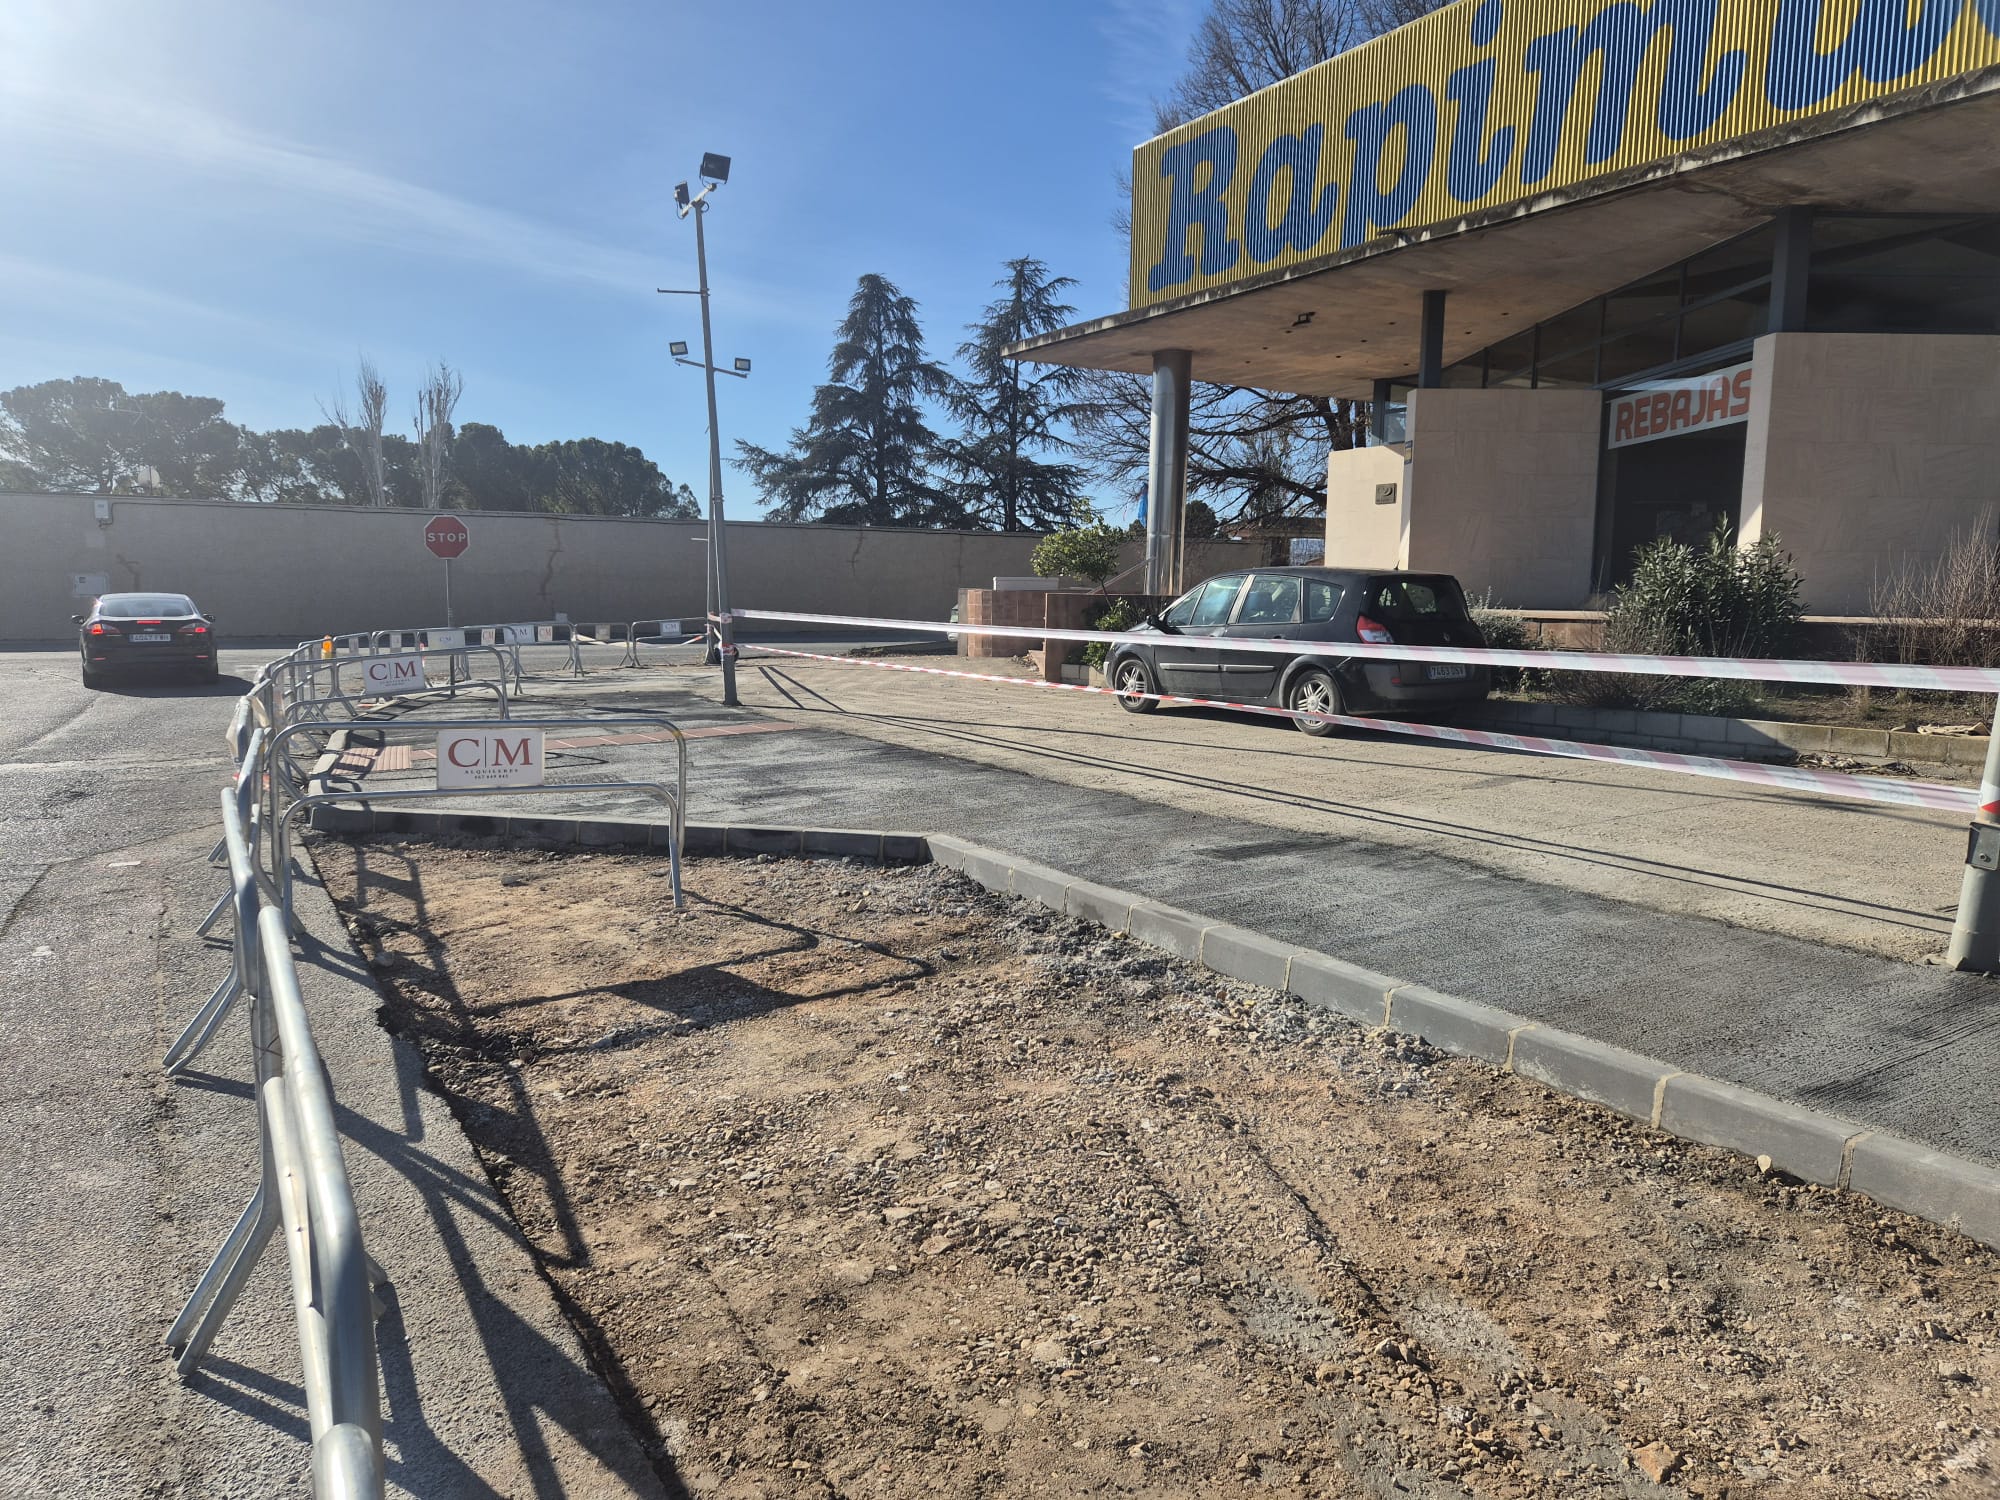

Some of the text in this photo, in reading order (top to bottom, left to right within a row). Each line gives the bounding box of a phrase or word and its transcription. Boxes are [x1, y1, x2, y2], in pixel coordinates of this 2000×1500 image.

[1148, 0, 2000, 292] Rapimu
[1615, 368, 1753, 442] REBAJAS
[427, 532, 466, 543] STOP
